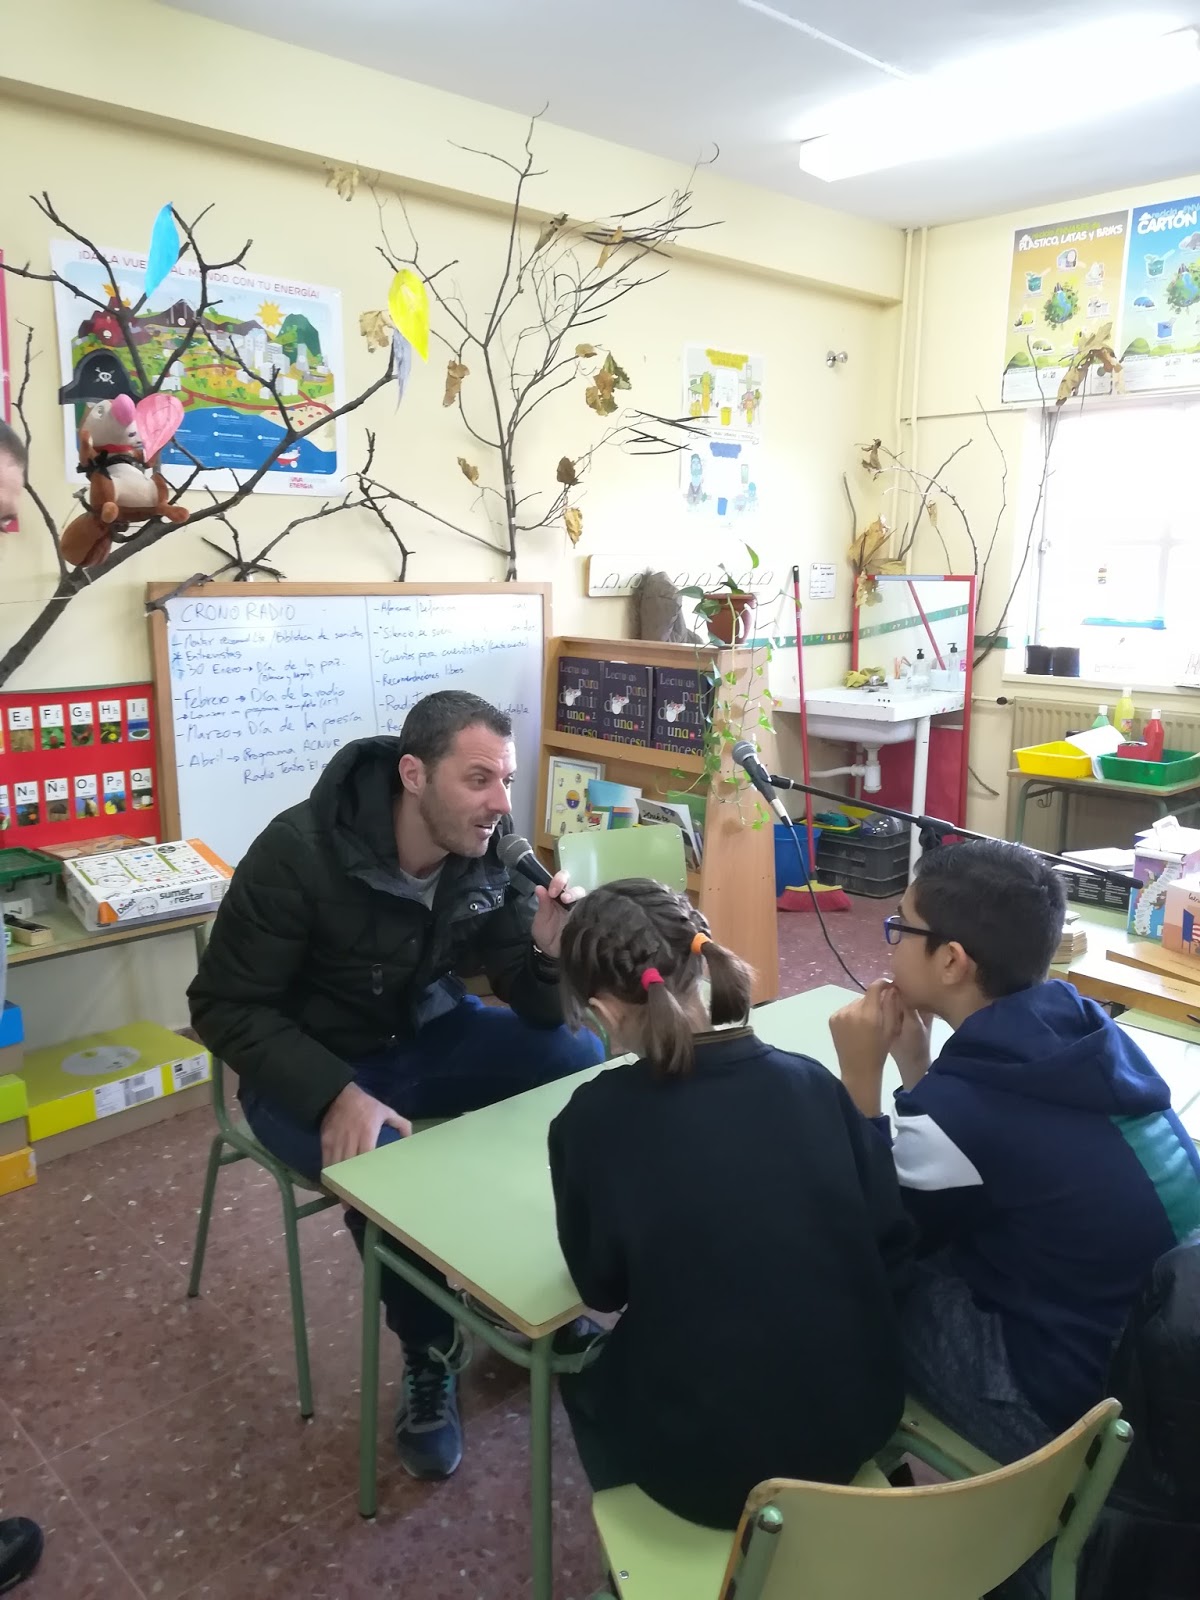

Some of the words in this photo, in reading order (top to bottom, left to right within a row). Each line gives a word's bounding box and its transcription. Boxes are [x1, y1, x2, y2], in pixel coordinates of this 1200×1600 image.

[1060, 231, 1087, 244] LATAS
[1096, 224, 1124, 238] BRIKS
[123, 255, 146, 270] VUE
[188, 268, 230, 284] MNDO
[232, 275, 255, 288] CON
[257, 279, 271, 291] TU
[181, 602, 240, 622] CRONO
[246, 602, 296, 621] RADIO
[284, 659, 298, 671] de
[660, 672, 696, 688] Lectuas
[281, 686, 297, 700] de
[559, 685, 598, 709] drmir
[102, 704, 111, 715] H
[132, 702, 136, 713] I
[604, 692, 648, 717] drmir
[13, 711, 21, 722] E
[43, 709, 51, 720] F
[72, 706, 82, 717] G
[566, 709, 586, 721] una
[279, 716, 296, 732] de
[613, 718, 634, 731] una
[667, 726, 690, 739] una
[76, 778, 87, 789] O
[107, 776, 115, 787] P
[132, 772, 143, 783] Q
[17, 786, 27, 797] N
[47, 780, 57, 793] Ñ
[159, 887, 192, 900] sumar
[174, 891, 205, 904] restar
